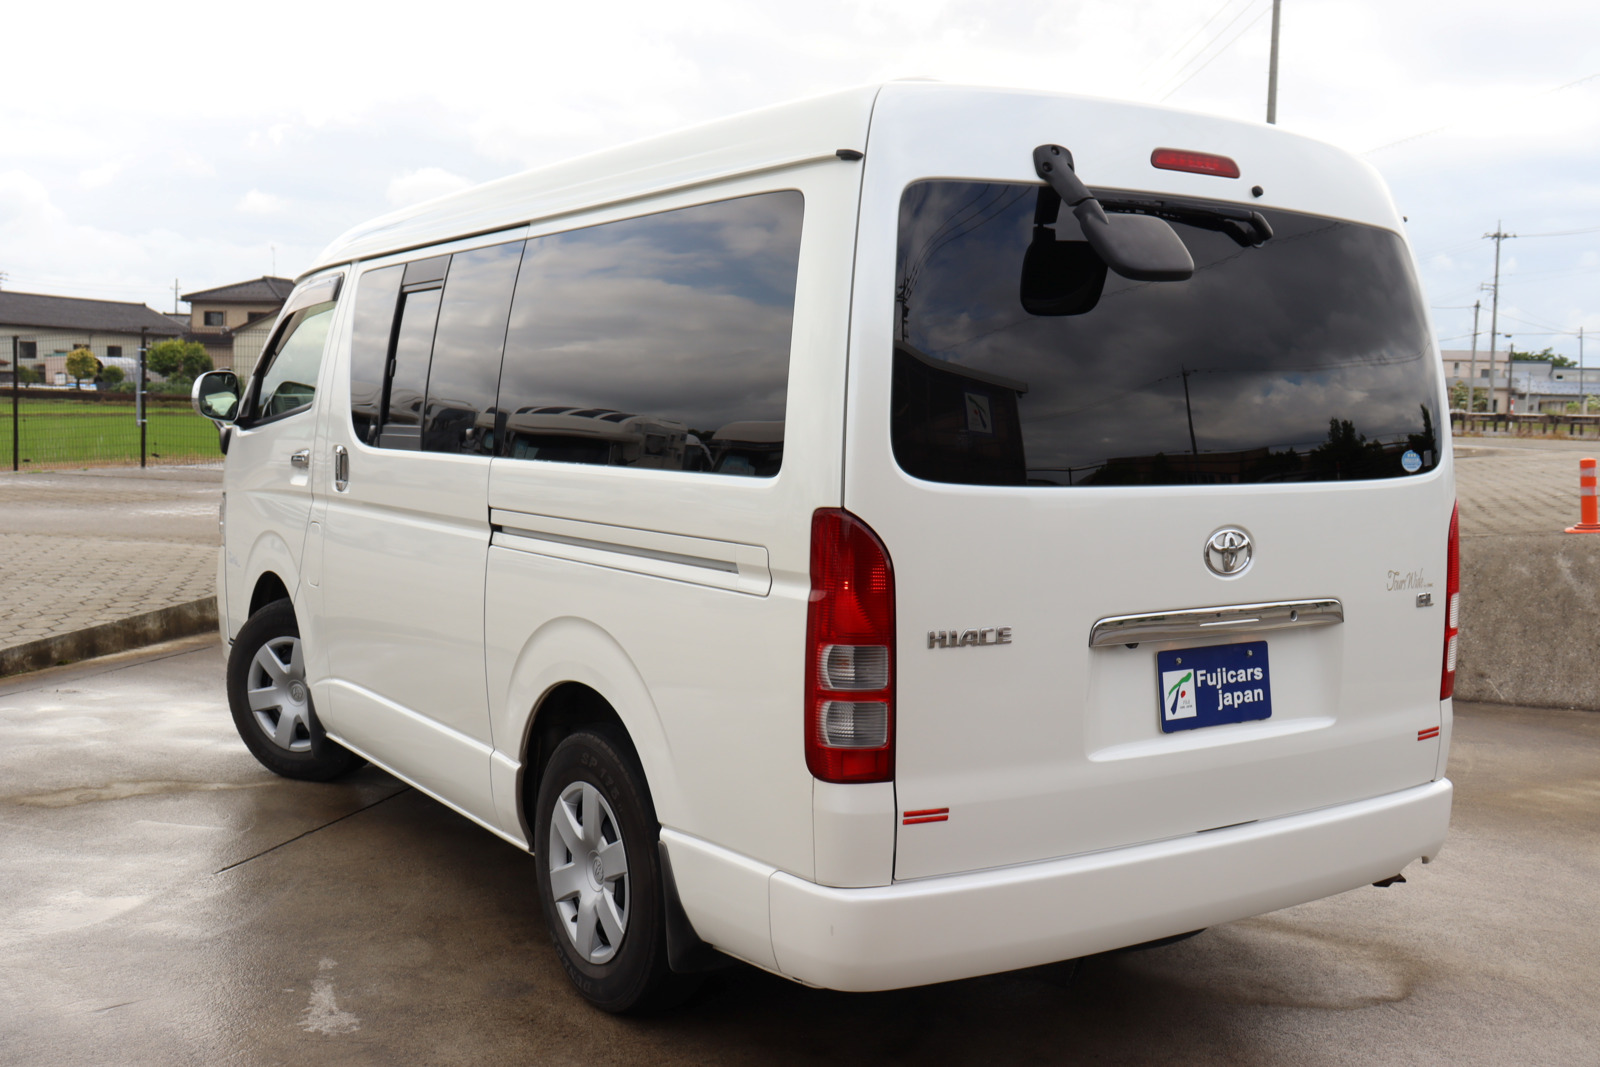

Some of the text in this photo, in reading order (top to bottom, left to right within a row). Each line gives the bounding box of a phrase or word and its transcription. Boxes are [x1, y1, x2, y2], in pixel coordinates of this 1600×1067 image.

[926, 625, 1012, 650] HIACE
[1196, 666, 1264, 689] Fujicars
[1217, 687, 1264, 711] japan
